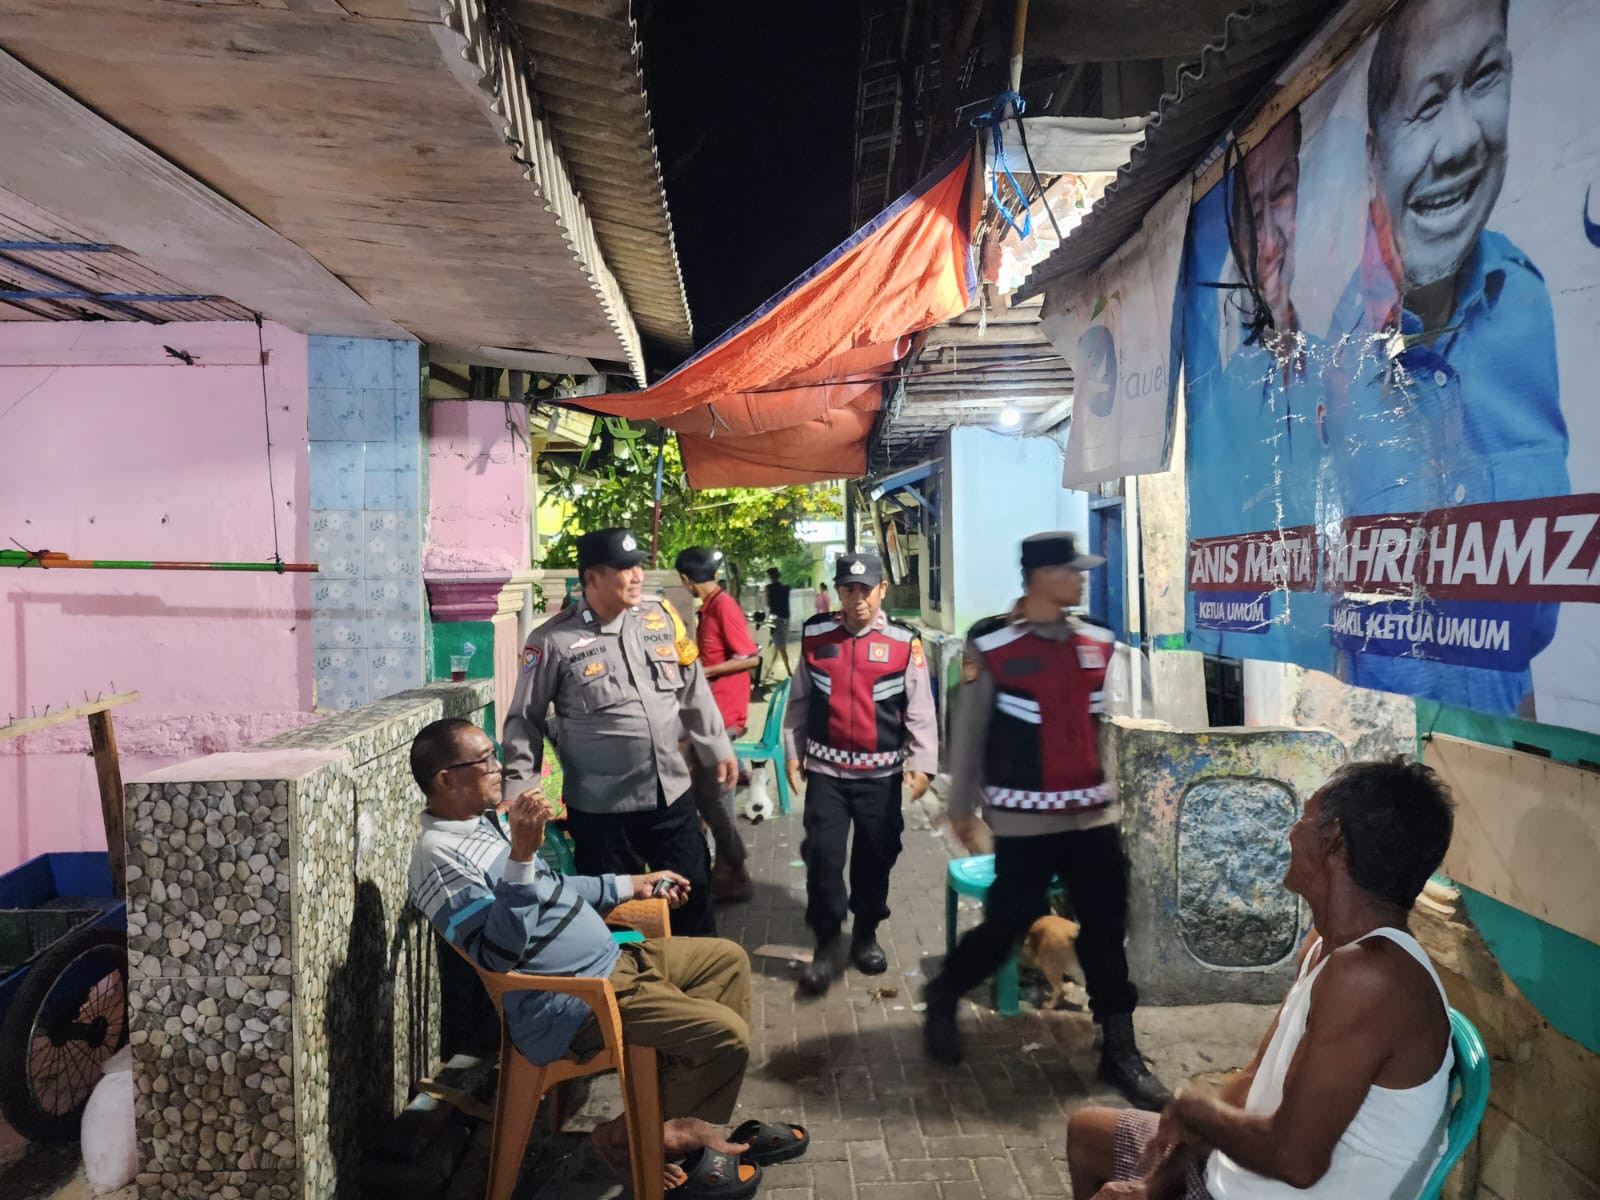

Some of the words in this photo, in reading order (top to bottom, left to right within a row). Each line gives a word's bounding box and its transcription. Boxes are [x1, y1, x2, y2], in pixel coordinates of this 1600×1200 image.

[1191, 543, 1239, 584] ANIS
[1426, 513, 1600, 586] HAMZ
[1199, 601, 1225, 620] KETUA
[1227, 603, 1265, 622] UMUM
[1367, 612, 1435, 643] KETUA
[1437, 617, 1510, 651] UMUM
